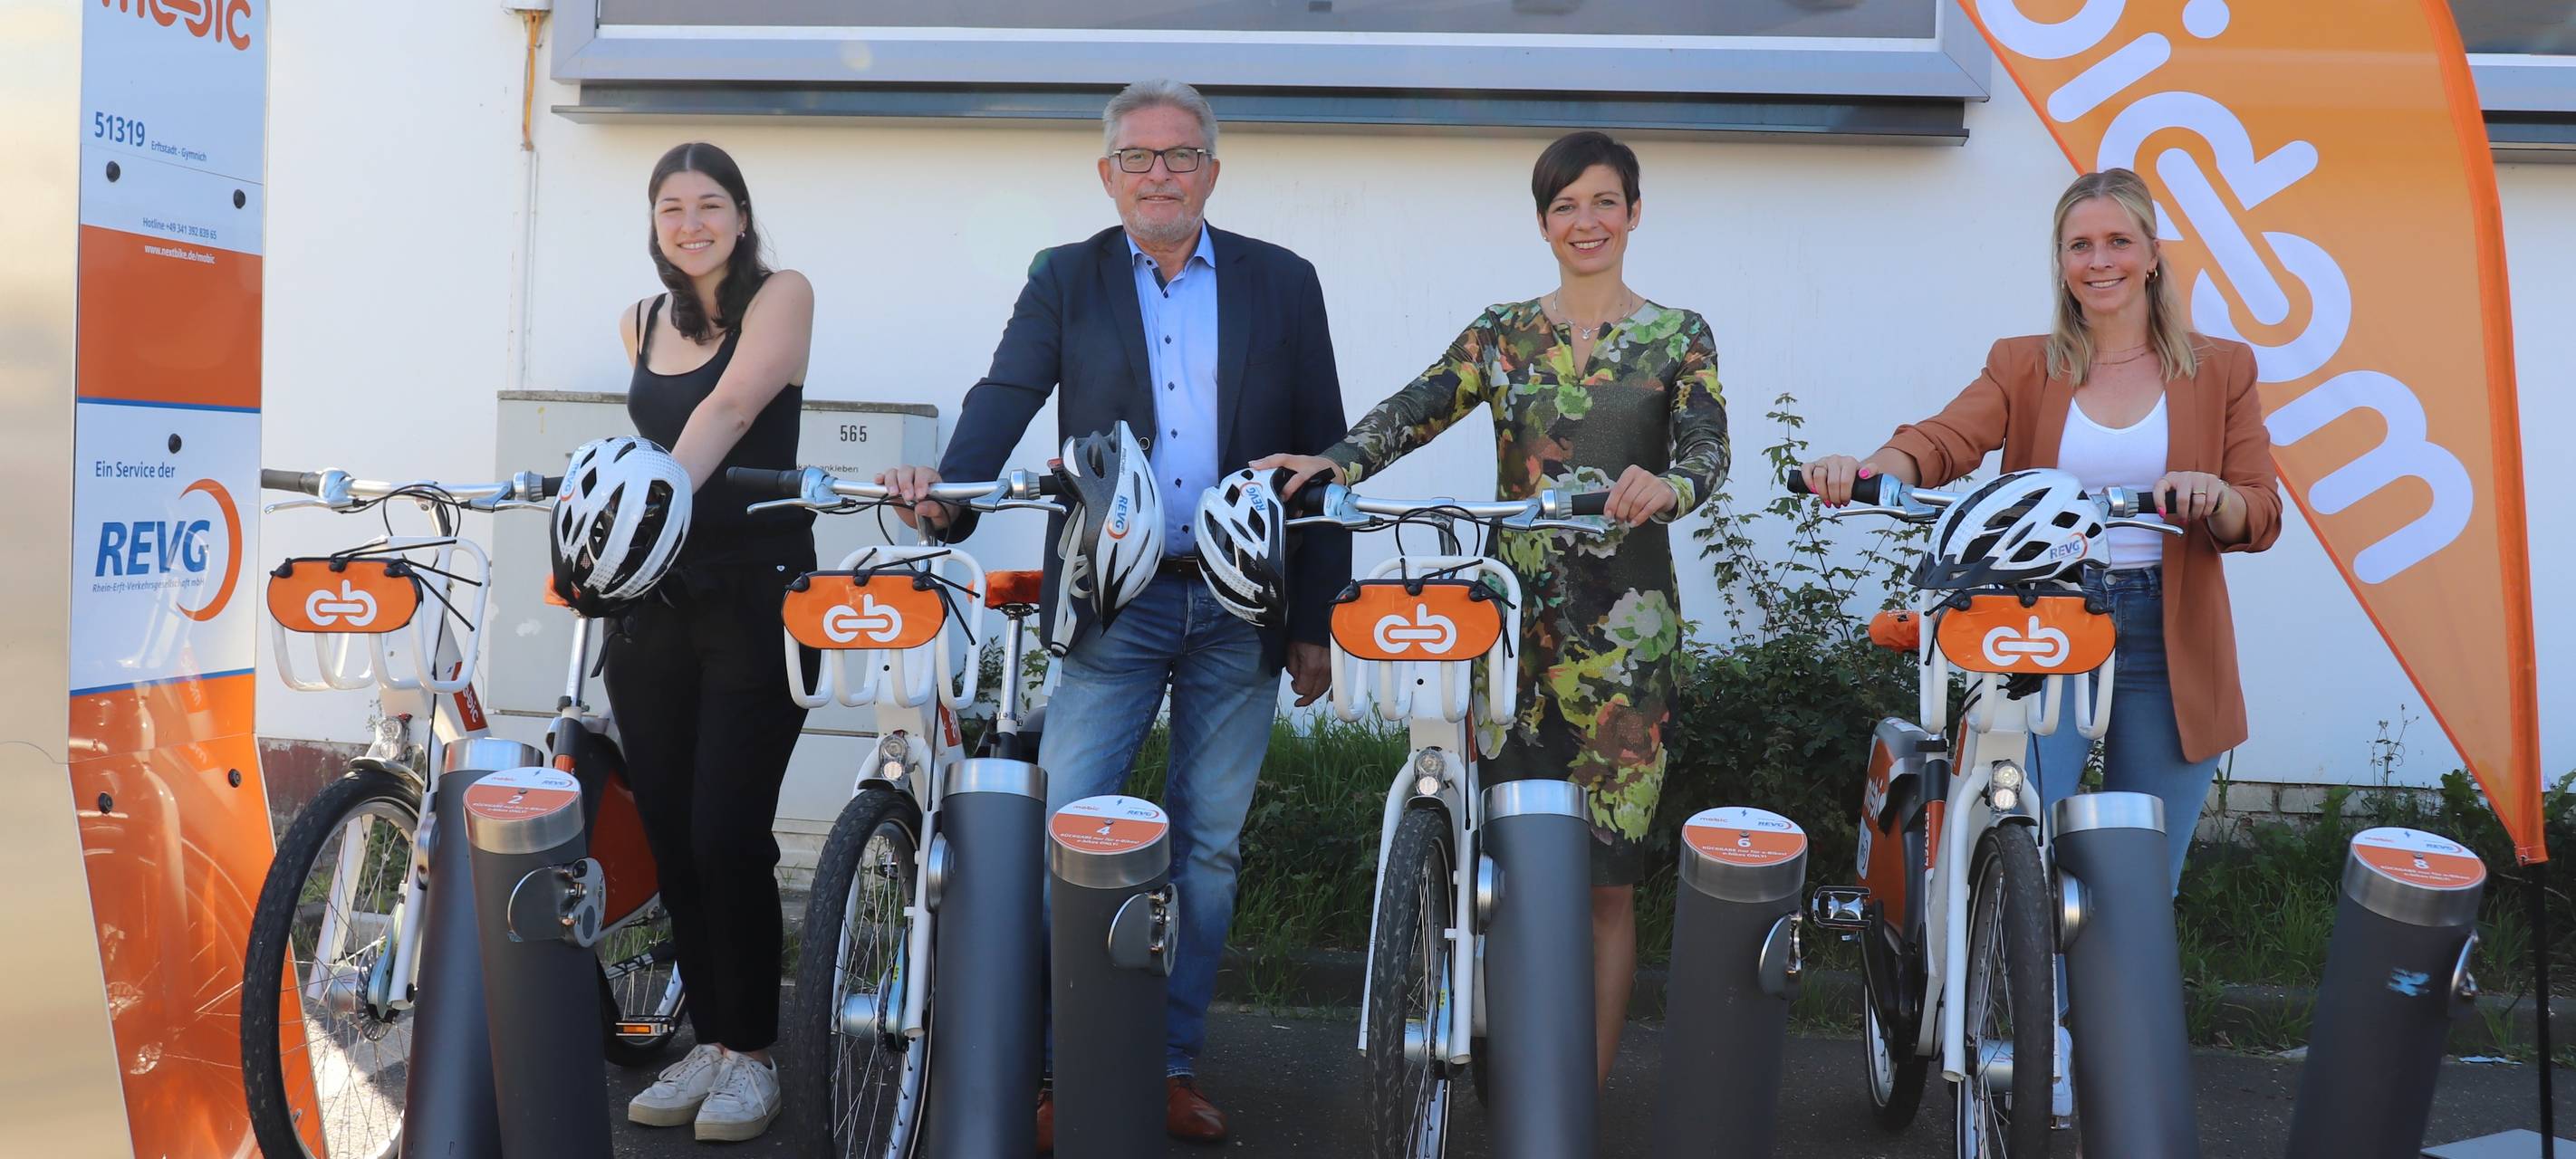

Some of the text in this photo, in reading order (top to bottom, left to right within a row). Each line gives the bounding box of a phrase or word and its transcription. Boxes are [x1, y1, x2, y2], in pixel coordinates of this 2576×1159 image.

[94, 111, 145, 147] 51319
[142, 217, 165, 230] Hotline
[840, 425, 868, 443] 565
[95, 461, 176, 478] Ein Service der
[1246, 487, 1266, 512] REVG
[1114, 494, 1129, 530] REVG
[95, 520, 210, 576] REVG
[2050, 540, 2081, 560] REVG
[507, 795, 524, 804] 2
[1096, 826, 1110, 835] 4
[1737, 838, 1752, 848] 6
[2413, 858, 2429, 869] 8
